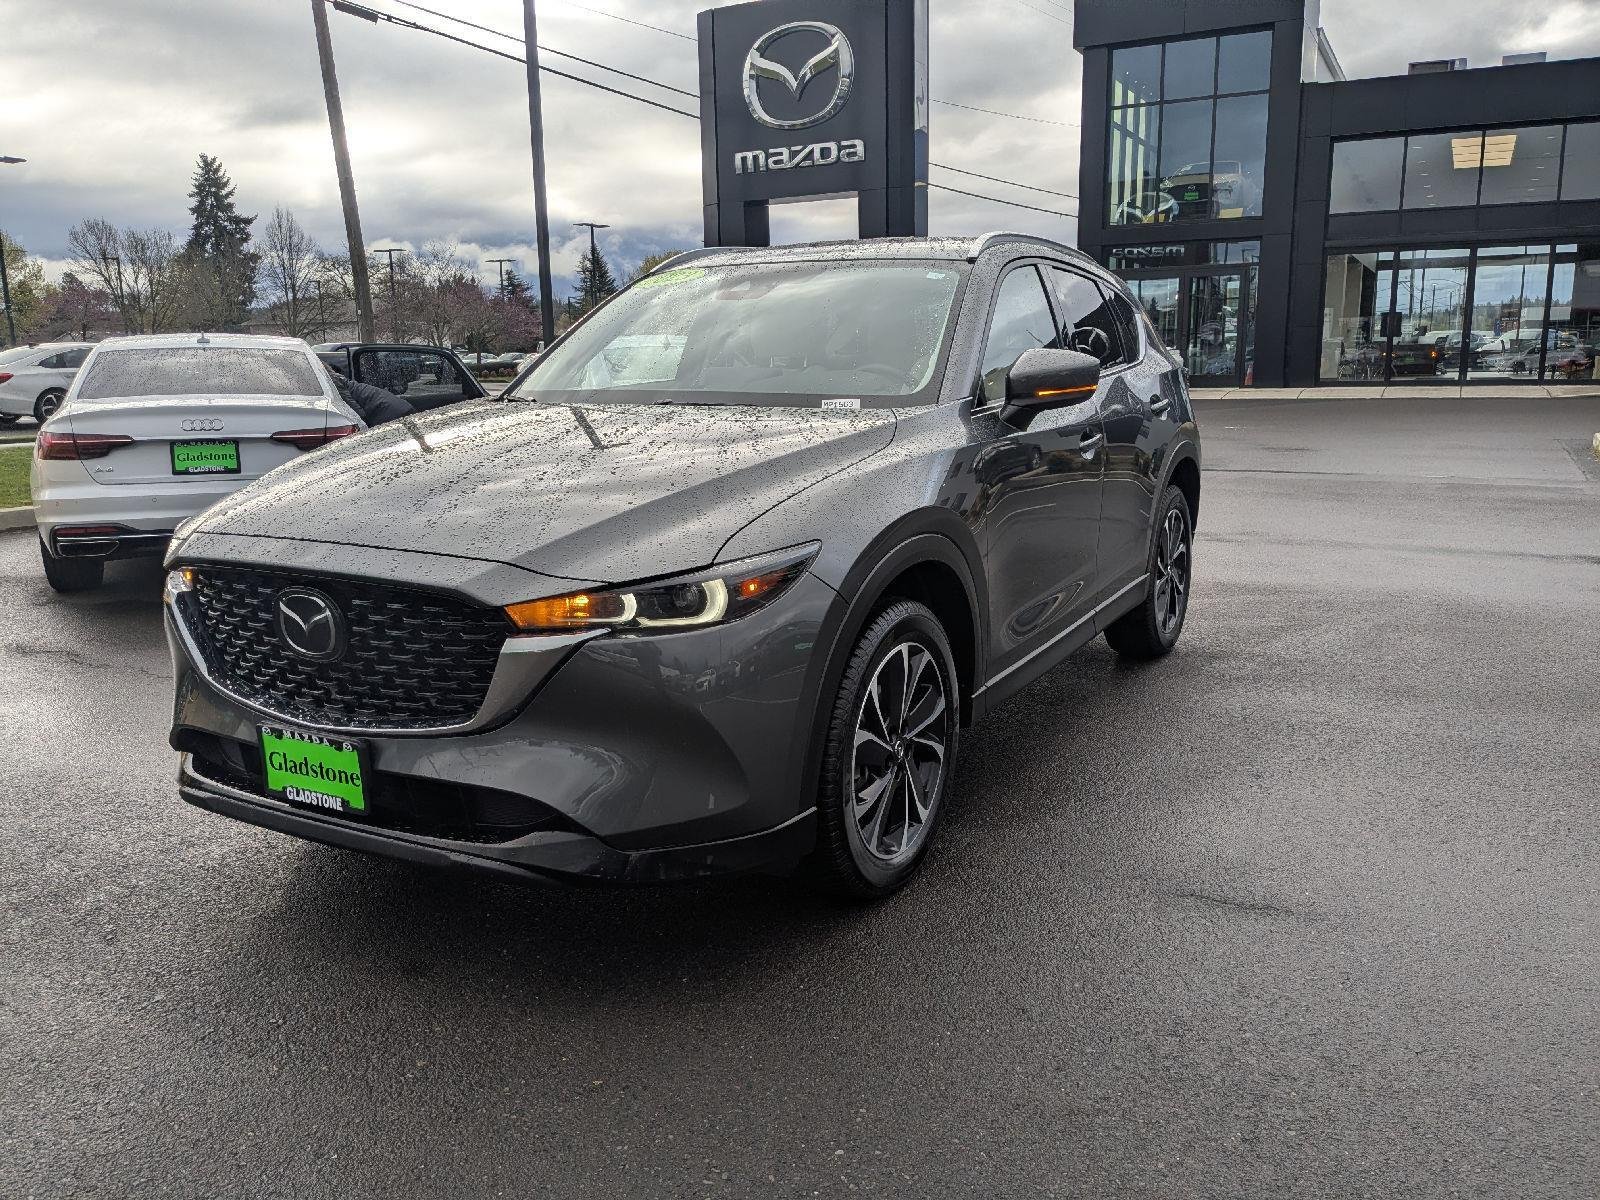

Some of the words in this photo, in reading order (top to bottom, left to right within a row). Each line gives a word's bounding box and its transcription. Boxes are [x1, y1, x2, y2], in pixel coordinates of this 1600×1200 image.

[734, 138, 865, 175] mazda
[176, 452, 236, 462] Gladstone
[188, 465, 225, 473] GLADSTONE
[282, 729, 330, 747] MAZDA
[268, 751, 361, 787] Gladstone
[286, 786, 344, 811] GLADSTONE
